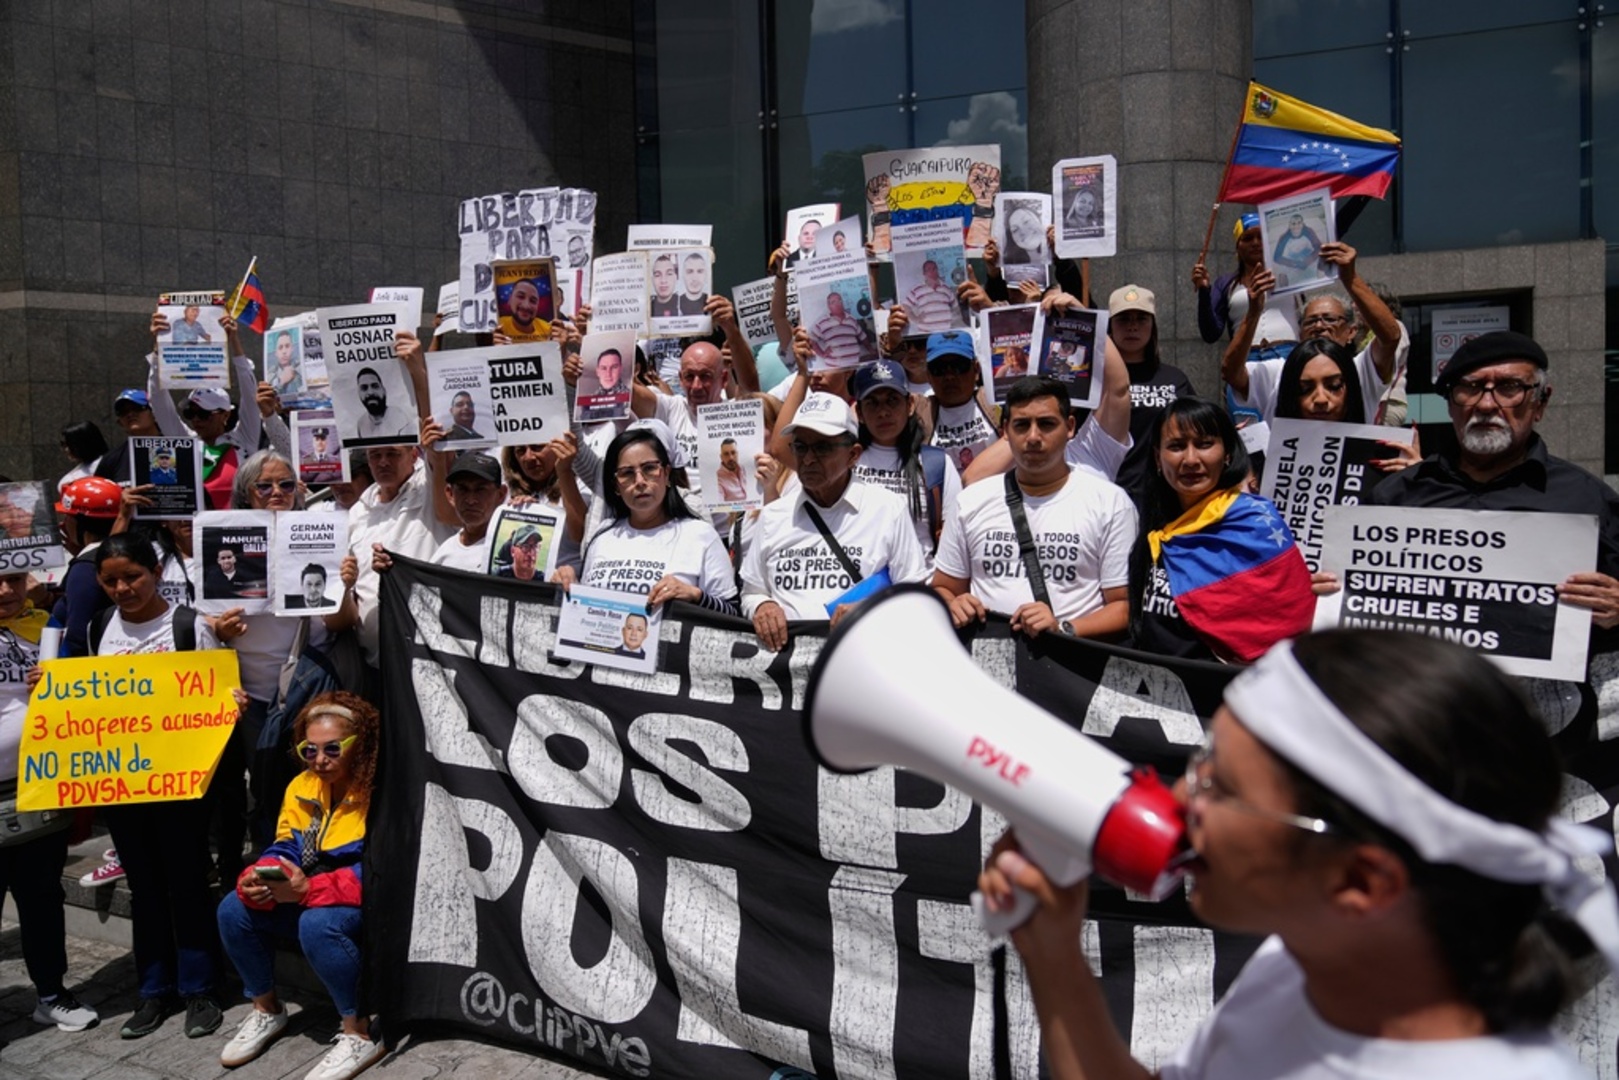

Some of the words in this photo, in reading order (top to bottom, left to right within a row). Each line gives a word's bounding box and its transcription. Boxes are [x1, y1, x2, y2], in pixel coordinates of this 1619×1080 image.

[330, 318, 369, 328] LIBERTAD
[370, 316, 394, 324] PARA
[334, 329, 395, 347] JOSNAR
[336, 346, 398, 364] BADUEL
[491, 382, 554, 400] CRIMEN
[699, 404, 730, 415] EXIGIMOS
[730, 401, 761, 411] LIBERTAD
[704, 412, 738, 421] INMEDIATA
[707, 423, 731, 432] VICTOR
[732, 421, 756, 430] MIGUEL
[135, 439, 192, 449] LIBERTAD
[1344, 463, 1365, 491] DE
[1290, 464, 1314, 542] PRESOS
[1304, 483, 1333, 574] OLÍTICOS
[1319, 436, 1341, 478] SON
[291, 522, 335, 532] GERMÁN
[222, 536, 267, 545] NAHUEL
[290, 532, 334, 542] GIULIANI
[986, 531, 1019, 543] LIBER
[1044, 532, 1081, 545] TODOS
[1352, 525, 1399, 544] LOS
[1406, 527, 1506, 549] PRESOS
[820, 546, 828, 556] A
[984, 543, 1013, 558] LOS
[634, 560, 666, 570] TODOS
[776, 559, 801, 573] LOS
[805, 558, 862, 573] PRESS
[1351, 547, 1484, 573] POLÍTICOS
[608, 568, 664, 582] PRESOS
[982, 559, 1077, 582] POLÍTCOS
[774, 571, 854, 592] POLÍTICO
[1349, 572, 1447, 597] SUFREN
[1451, 580, 1555, 606] TRATOS
[1346, 597, 1458, 621] CRUELES
[1464, 605, 1480, 624] E
[37, 667, 154, 700] Justicia
[174, 667, 216, 698] YA!
[1081, 655, 1204, 746] A
[31, 714, 49, 742] 3
[55, 710, 153, 747] choferes
[162, 702, 239, 732] acusados
[410, 657, 753, 833] LOS
[24, 751, 59, 783] NO
[70, 747, 121, 777] ERAN
[127, 742, 153, 773] de
[57, 769, 209, 807] PDVSA-CRIP
